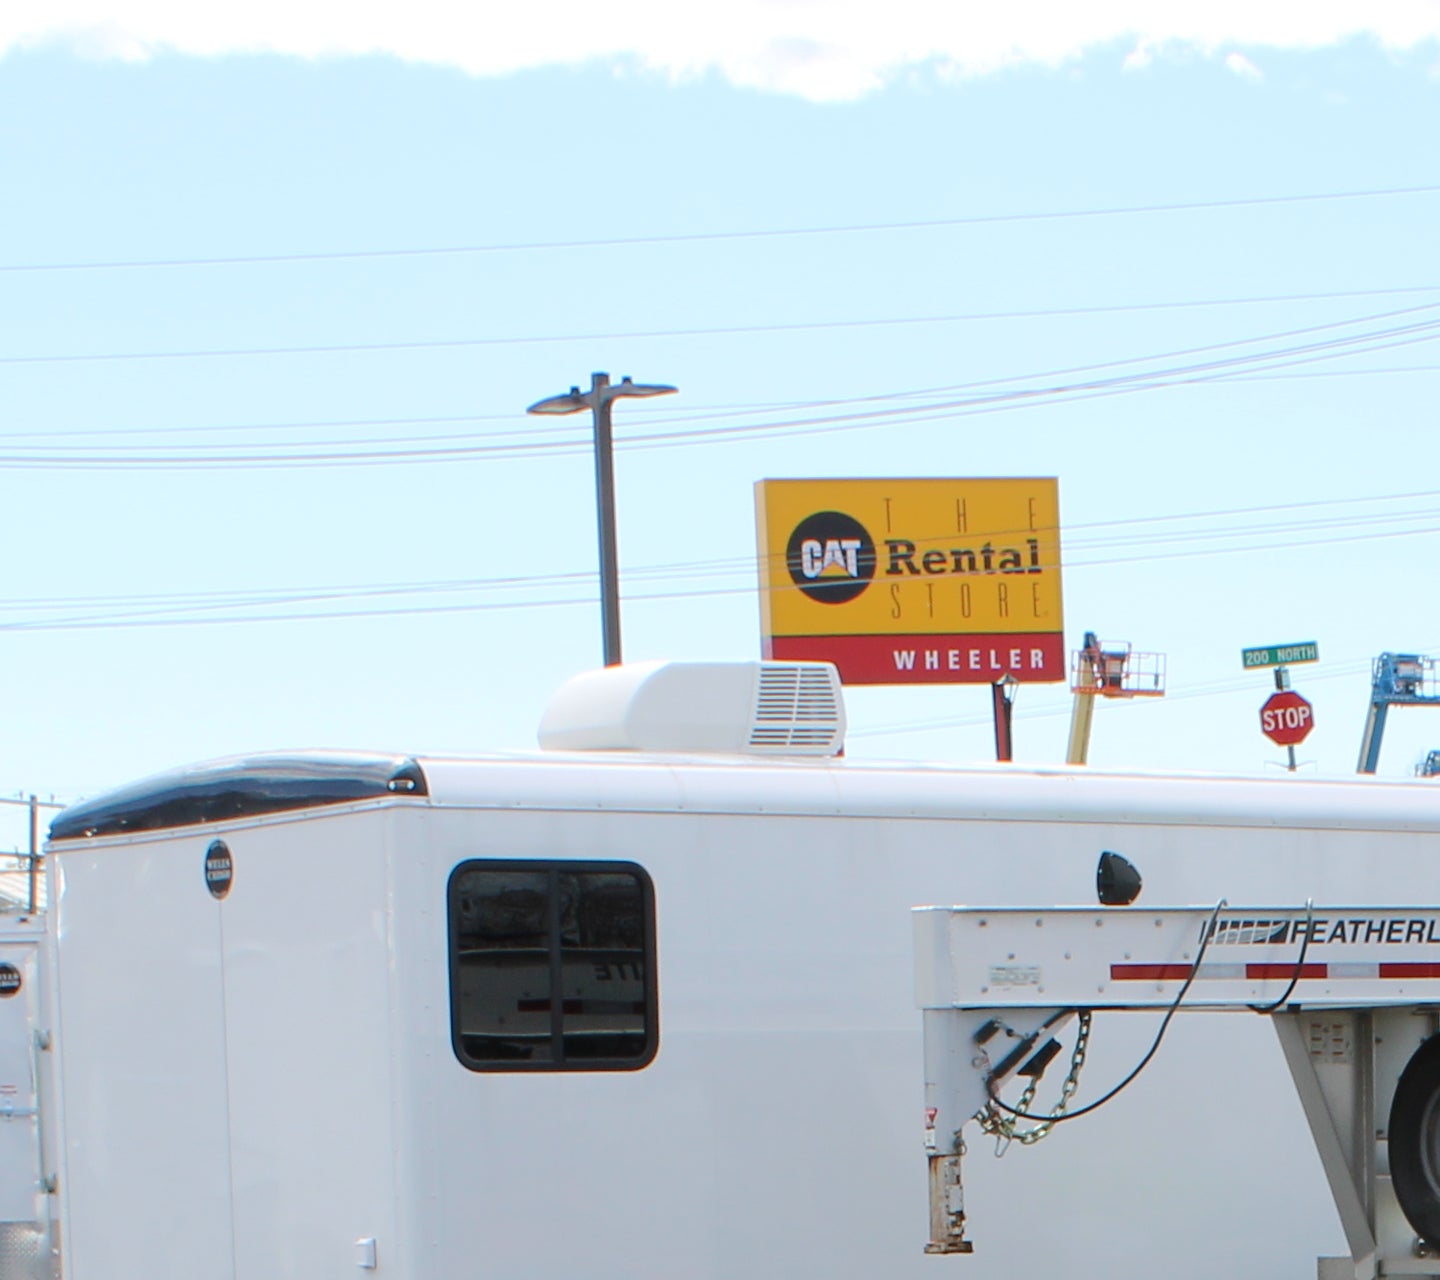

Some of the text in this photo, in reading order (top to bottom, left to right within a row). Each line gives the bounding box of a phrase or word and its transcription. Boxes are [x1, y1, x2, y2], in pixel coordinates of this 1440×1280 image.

[884, 497, 1037, 533] THE
[801, 537, 862, 579] CAT
[884, 538, 1043, 576] Rental
[891, 582, 1042, 619] STORE
[893, 649, 1044, 671] WHEELER
[1245, 644, 1316, 666] 200 NORTH
[1263, 705, 1310, 732] STOP
